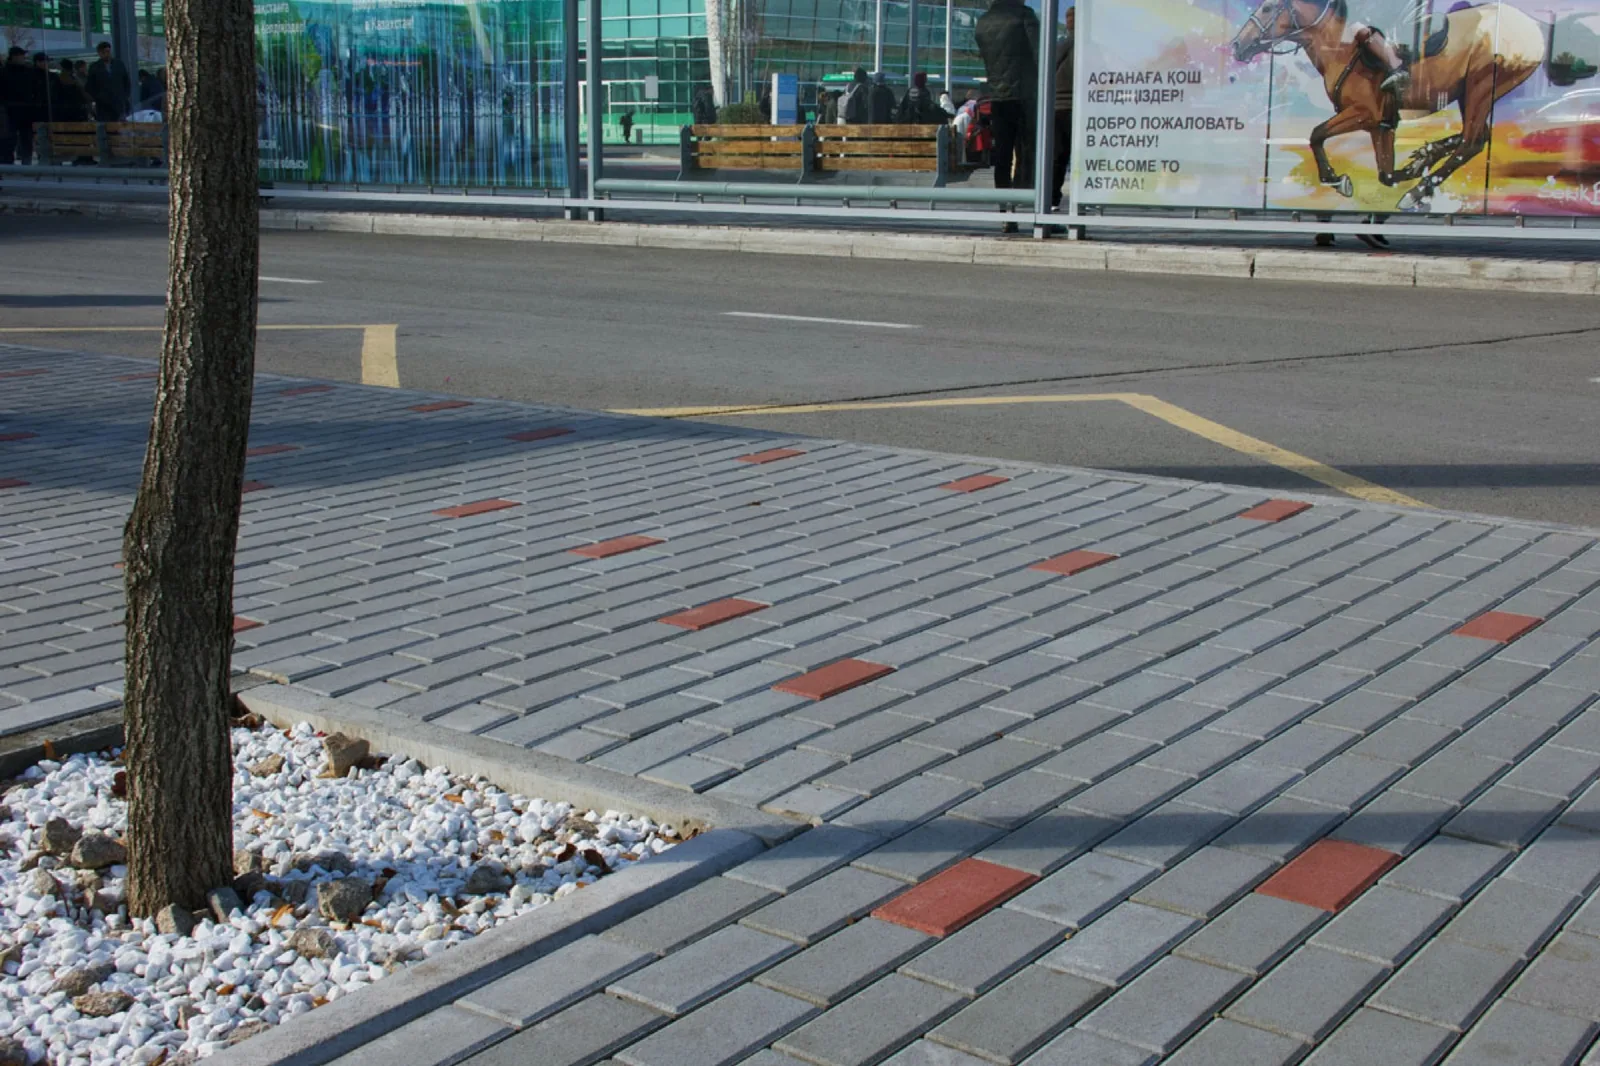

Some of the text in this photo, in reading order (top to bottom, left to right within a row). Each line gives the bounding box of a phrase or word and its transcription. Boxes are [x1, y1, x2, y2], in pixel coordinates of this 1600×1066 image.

[1088, 70, 1202, 86] АСТАНАҒА ҚОШ
[1086, 116, 1245, 132] ДОБРО ПОЖАЛОВАТЬ
[1086, 134, 1159, 148] В АСТАНУ!
[1085, 159, 1180, 173] WELCOME TO
[1084, 177, 1145, 190] ASTANA!
